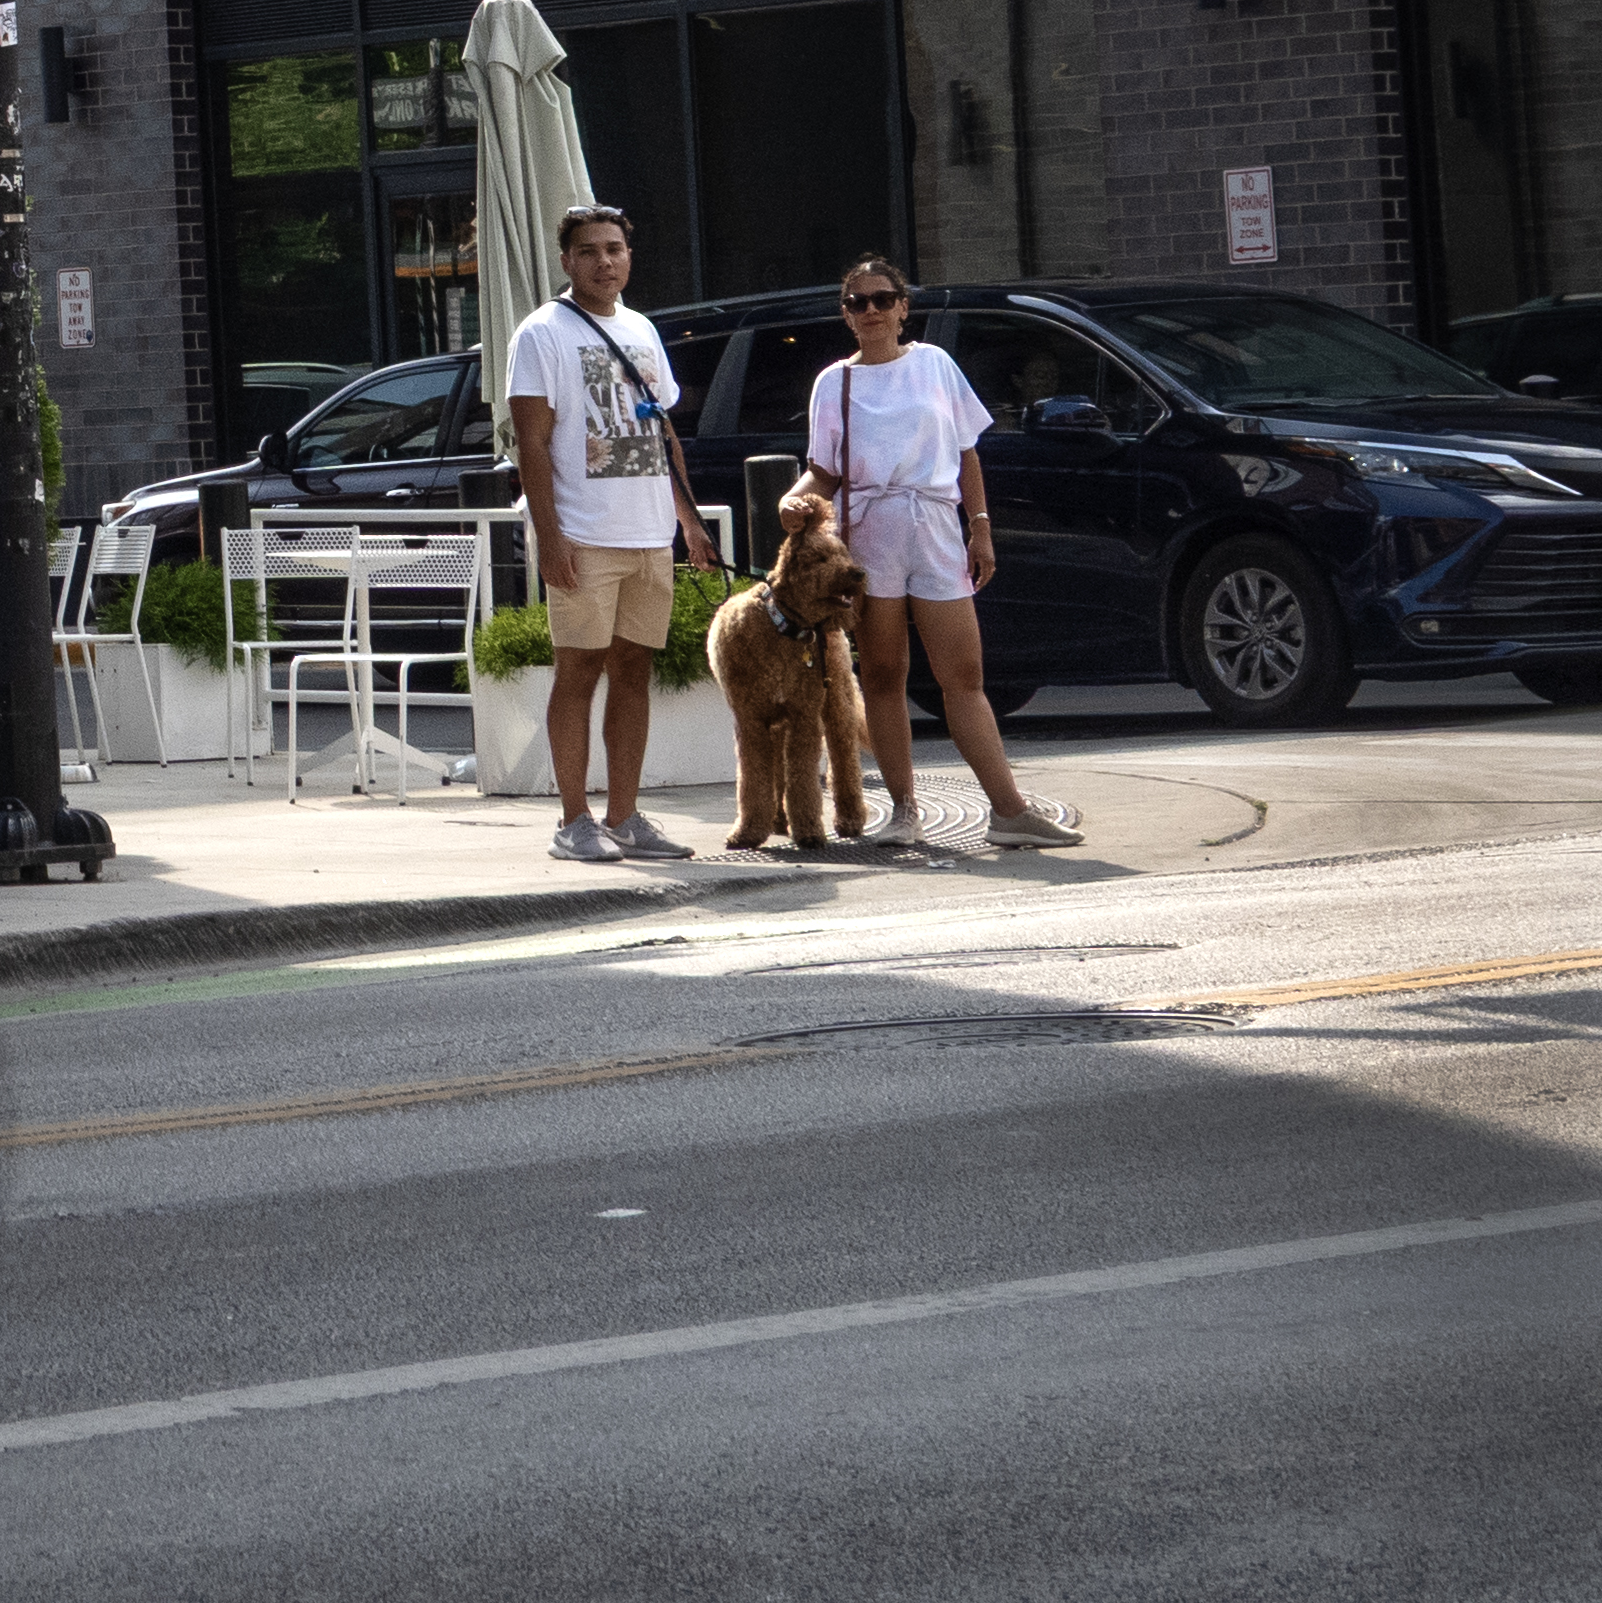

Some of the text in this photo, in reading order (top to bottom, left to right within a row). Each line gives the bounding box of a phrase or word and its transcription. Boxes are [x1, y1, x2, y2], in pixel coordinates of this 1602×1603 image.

[1241, 176, 1254, 191] NO
[1231, 194, 1268, 211] PARKING
[1241, 216, 1261, 226] TOW
[1239, 228, 1264, 239] ZONE
[69, 276, 80, 286] NO
[61, 289, 89, 300] PARKING
[69, 303, 82, 313] TOW
[68, 316, 84, 326] AWAY
[68, 329, 86, 340] ZONE
